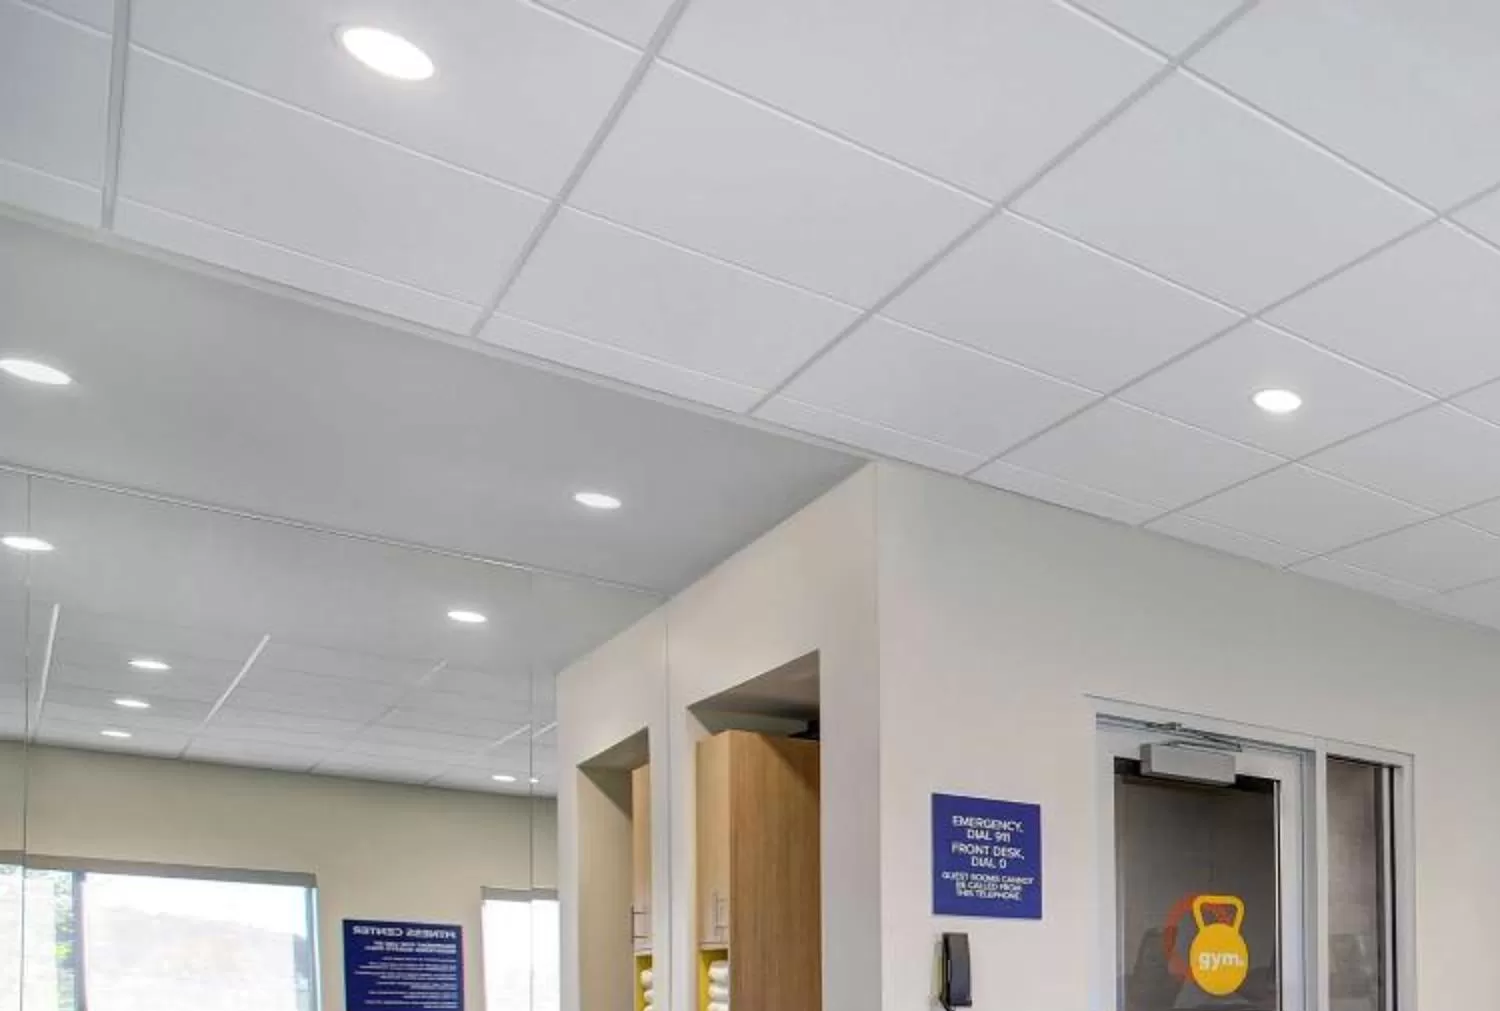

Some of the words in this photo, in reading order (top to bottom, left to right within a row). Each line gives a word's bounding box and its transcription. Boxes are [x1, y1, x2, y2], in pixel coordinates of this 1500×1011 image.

[967, 829, 992, 841] DIAL
[995, 831, 1011, 843] 911
[951, 842, 990, 856] FRONT
[971, 856, 996, 869] DIAL
